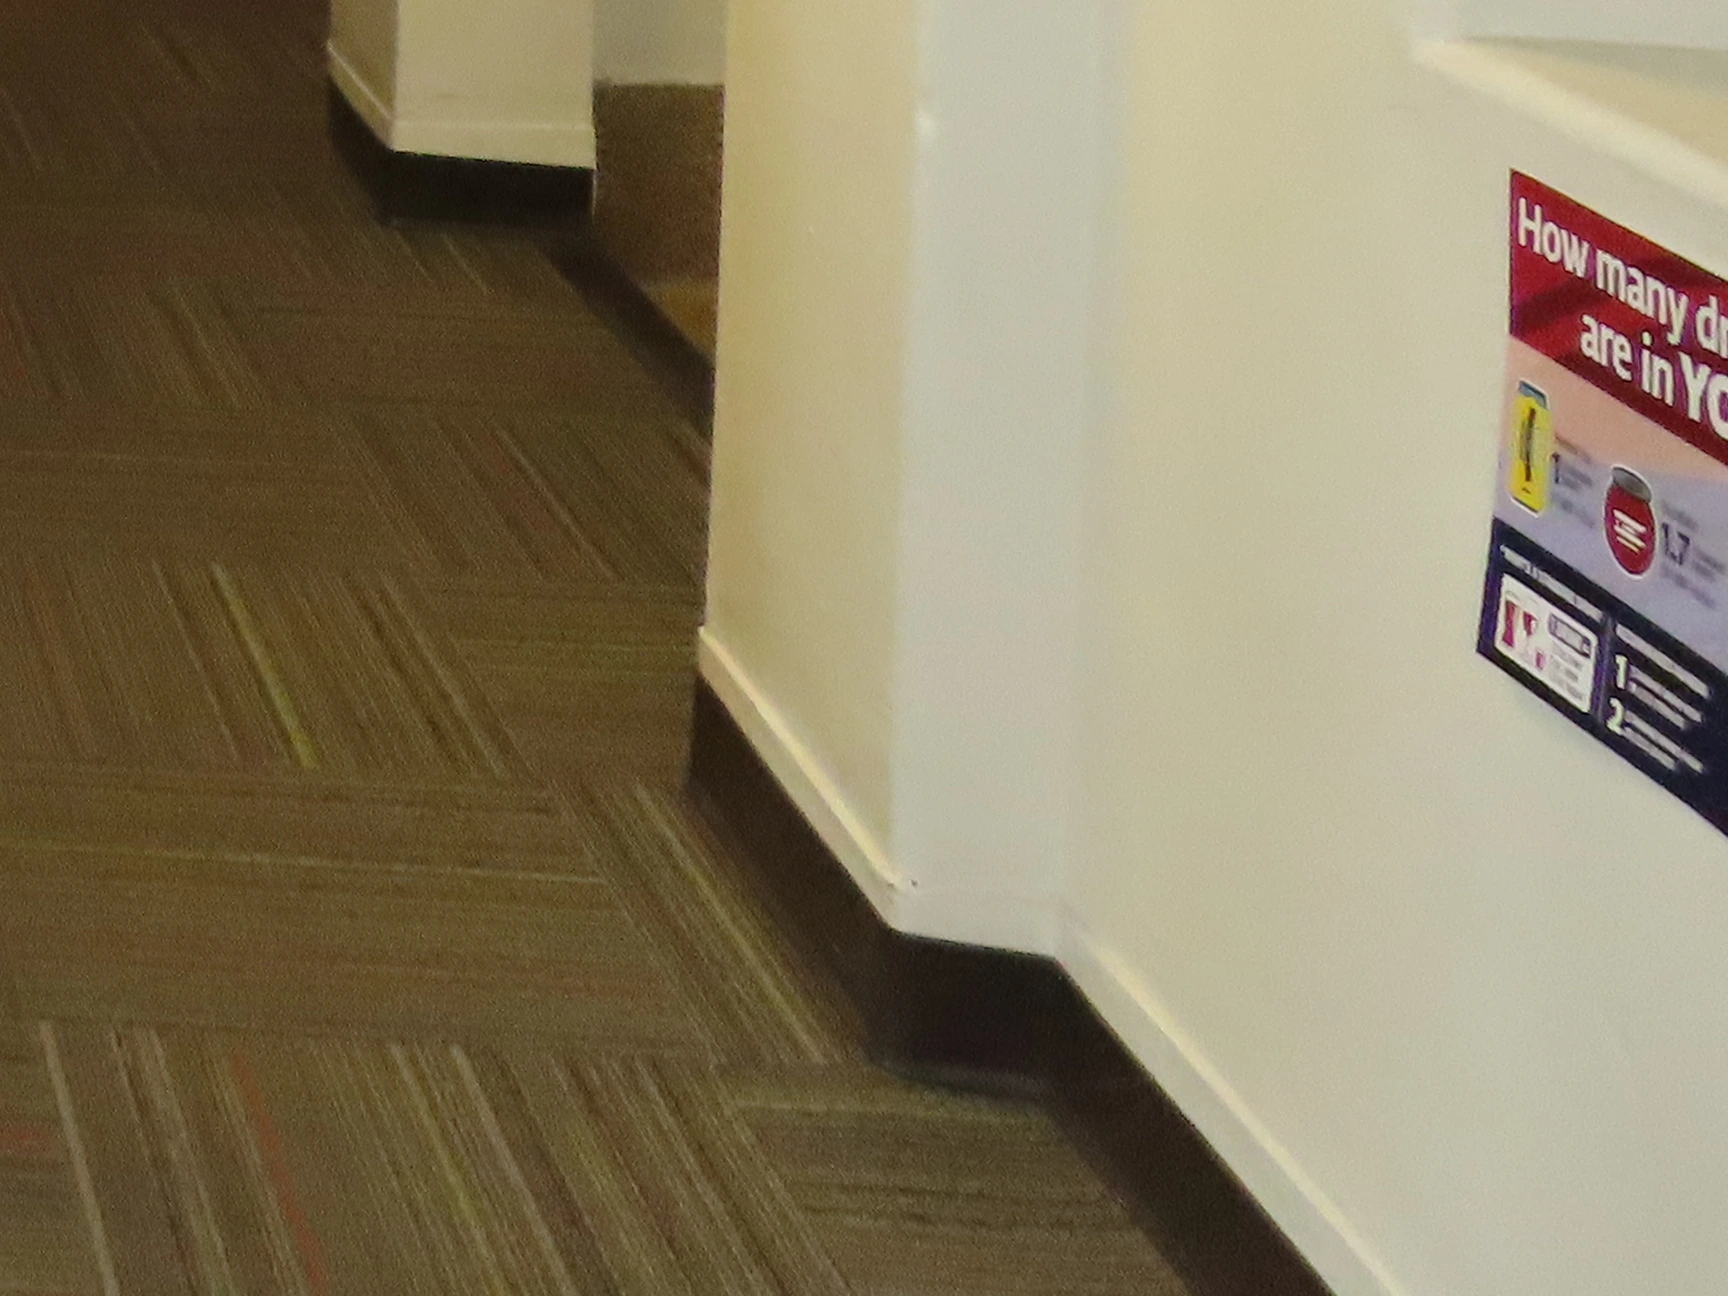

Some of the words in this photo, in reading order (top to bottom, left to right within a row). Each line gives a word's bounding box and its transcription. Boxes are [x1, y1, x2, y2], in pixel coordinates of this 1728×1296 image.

[1517, 196, 1590, 278] How
[1595, 248, 1690, 347] many
[1580, 313, 1633, 382] are
[1641, 332, 1674, 407] in
[1678, 350, 1728, 442] YO
[1607, 697, 1626, 736] 2
